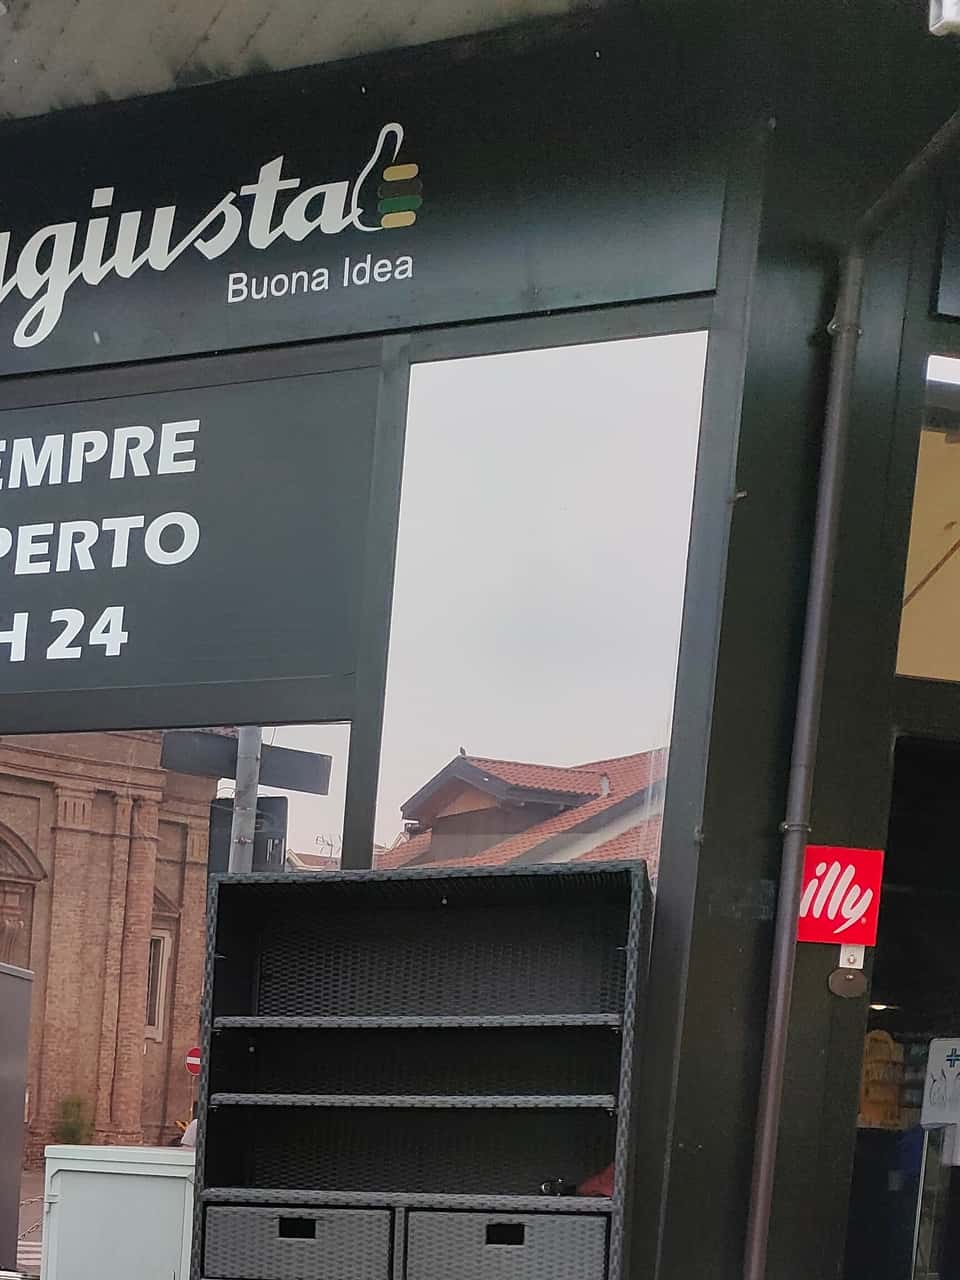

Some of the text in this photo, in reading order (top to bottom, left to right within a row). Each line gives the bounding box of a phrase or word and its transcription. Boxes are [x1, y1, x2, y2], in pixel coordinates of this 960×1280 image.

[228, 254, 412, 303] Buona Idea
[46, 606, 128, 659] 24
[800, 861, 874, 934] illy
